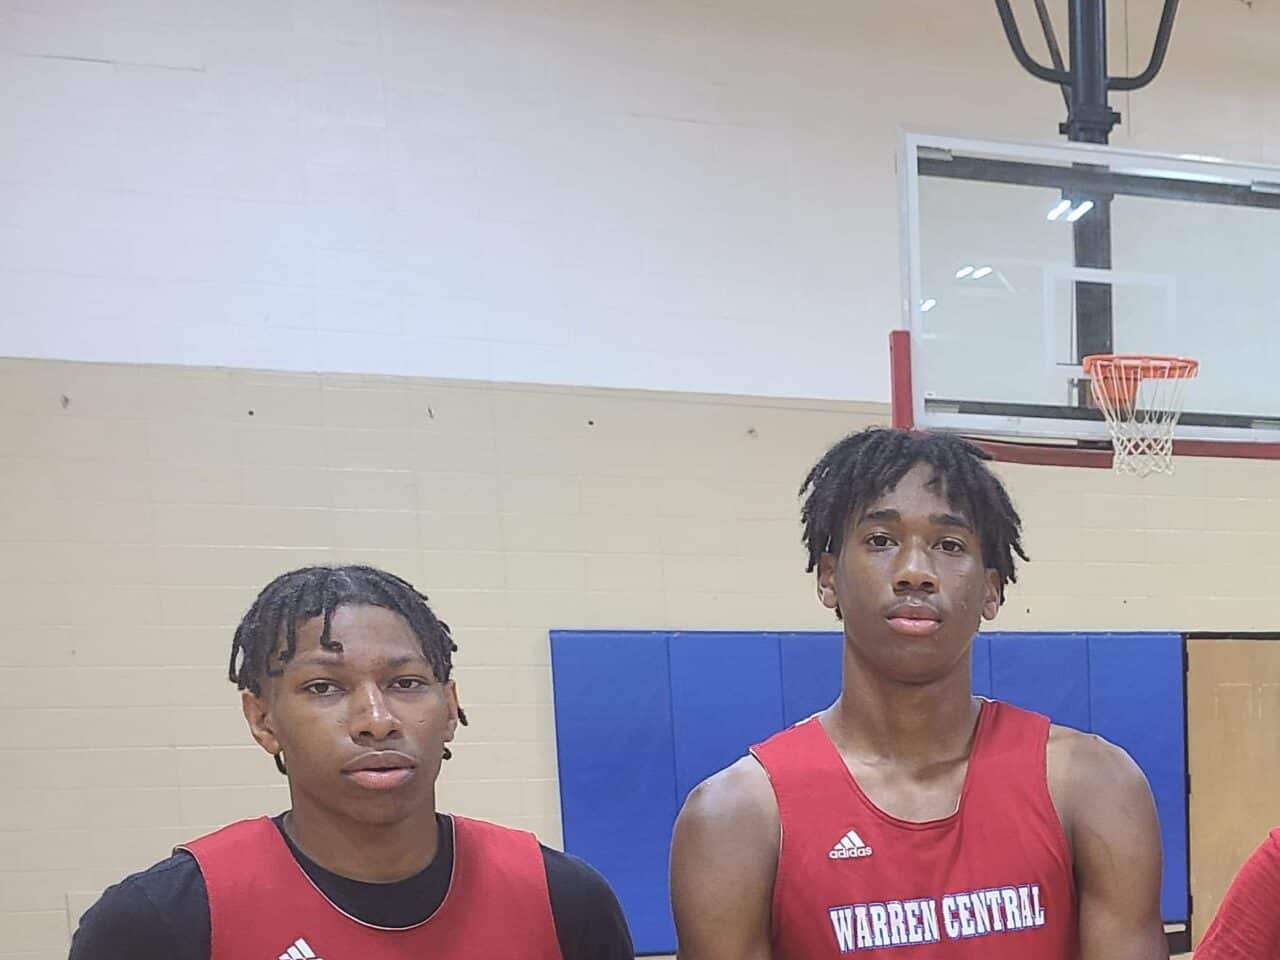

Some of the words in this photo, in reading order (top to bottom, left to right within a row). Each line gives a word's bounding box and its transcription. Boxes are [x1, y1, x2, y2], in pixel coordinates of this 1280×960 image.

[828, 845, 872, 859] adidas
[829, 898, 941, 954] WARREN
[942, 883, 1045, 941] CENTRAL
